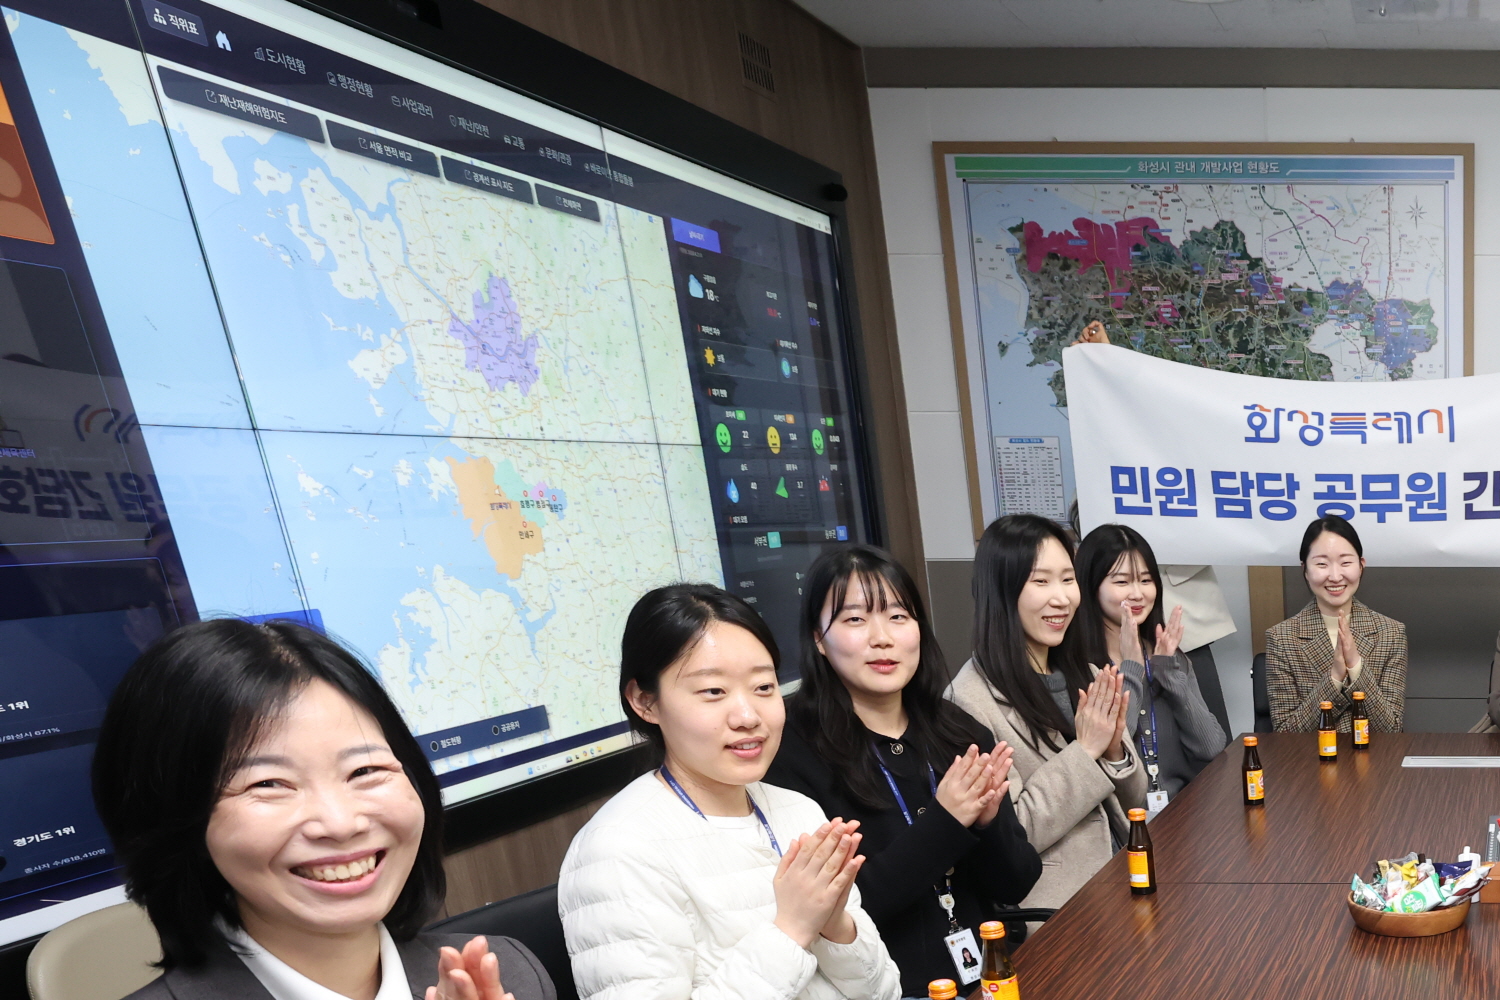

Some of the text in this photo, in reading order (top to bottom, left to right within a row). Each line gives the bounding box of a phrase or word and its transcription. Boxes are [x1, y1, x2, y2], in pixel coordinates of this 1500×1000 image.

[168, 13, 200, 36] 직위표
[217, 93, 288, 124] 재난재해위험지도
[265, 48, 307, 75] 도시현황
[337, 73, 374, 98] 행정현황
[401, 97, 434, 119] 사업관리
[457, 117, 490, 139] 재난/안전
[511, 135, 525, 151] 교통
[369, 140, 413, 163] 서울 면적 비교
[1138, 160, 1281, 174] 화성시 관내 개발사업 현황도
[472, 171, 515, 193] 경계선 표시 지도
[1243, 403, 1455, 447] 화성특례시
[1110, 465, 1198, 517] 민원
[1211, 470, 1300, 521] 담당
[1313, 472, 1447, 523] 공무원
[8, 700, 30, 711] 1위
[13, 825, 76, 847] 경기도 1위
[24, 861, 50, 874] 종사자
